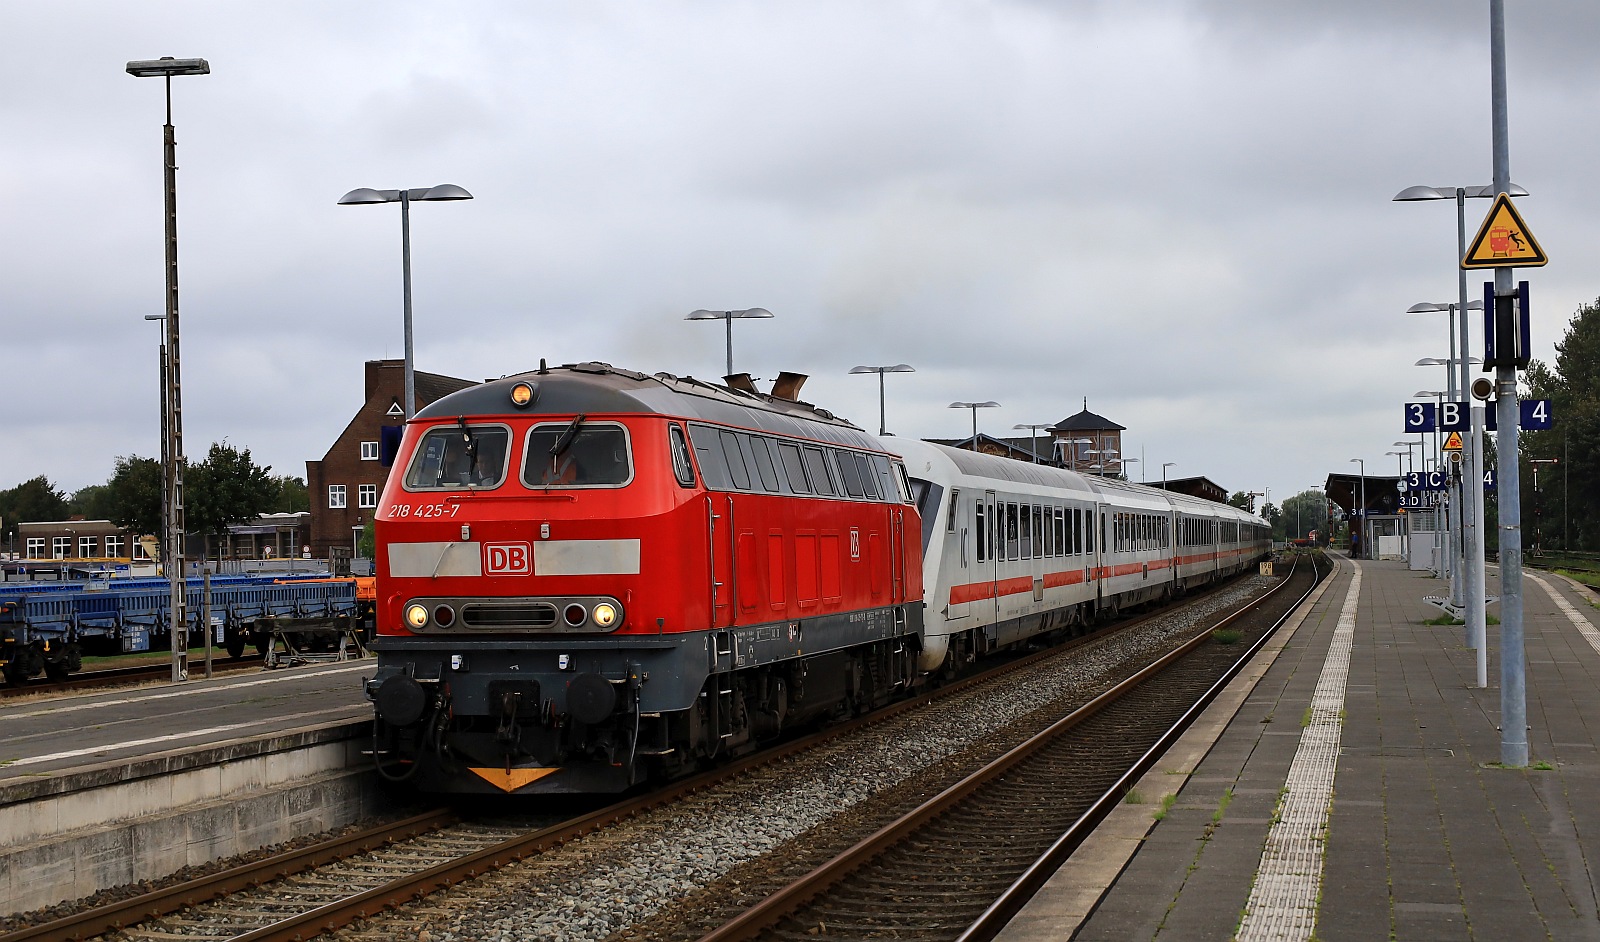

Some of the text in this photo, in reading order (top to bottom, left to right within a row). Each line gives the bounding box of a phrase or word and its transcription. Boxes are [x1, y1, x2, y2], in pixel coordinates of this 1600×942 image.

[1409, 402, 1460, 426] 3 B
[1532, 400, 1548, 423] 4
[1409, 471, 1442, 487] 3 C
[1483, 470, 1493, 485] 4
[1399, 496, 1419, 506] 3 D
[388, 503, 461, 518] 218 425-7
[1351, 508, 1357, 516] 3
[960, 527, 968, 569] IC
[488, 546, 528, 572] DB
